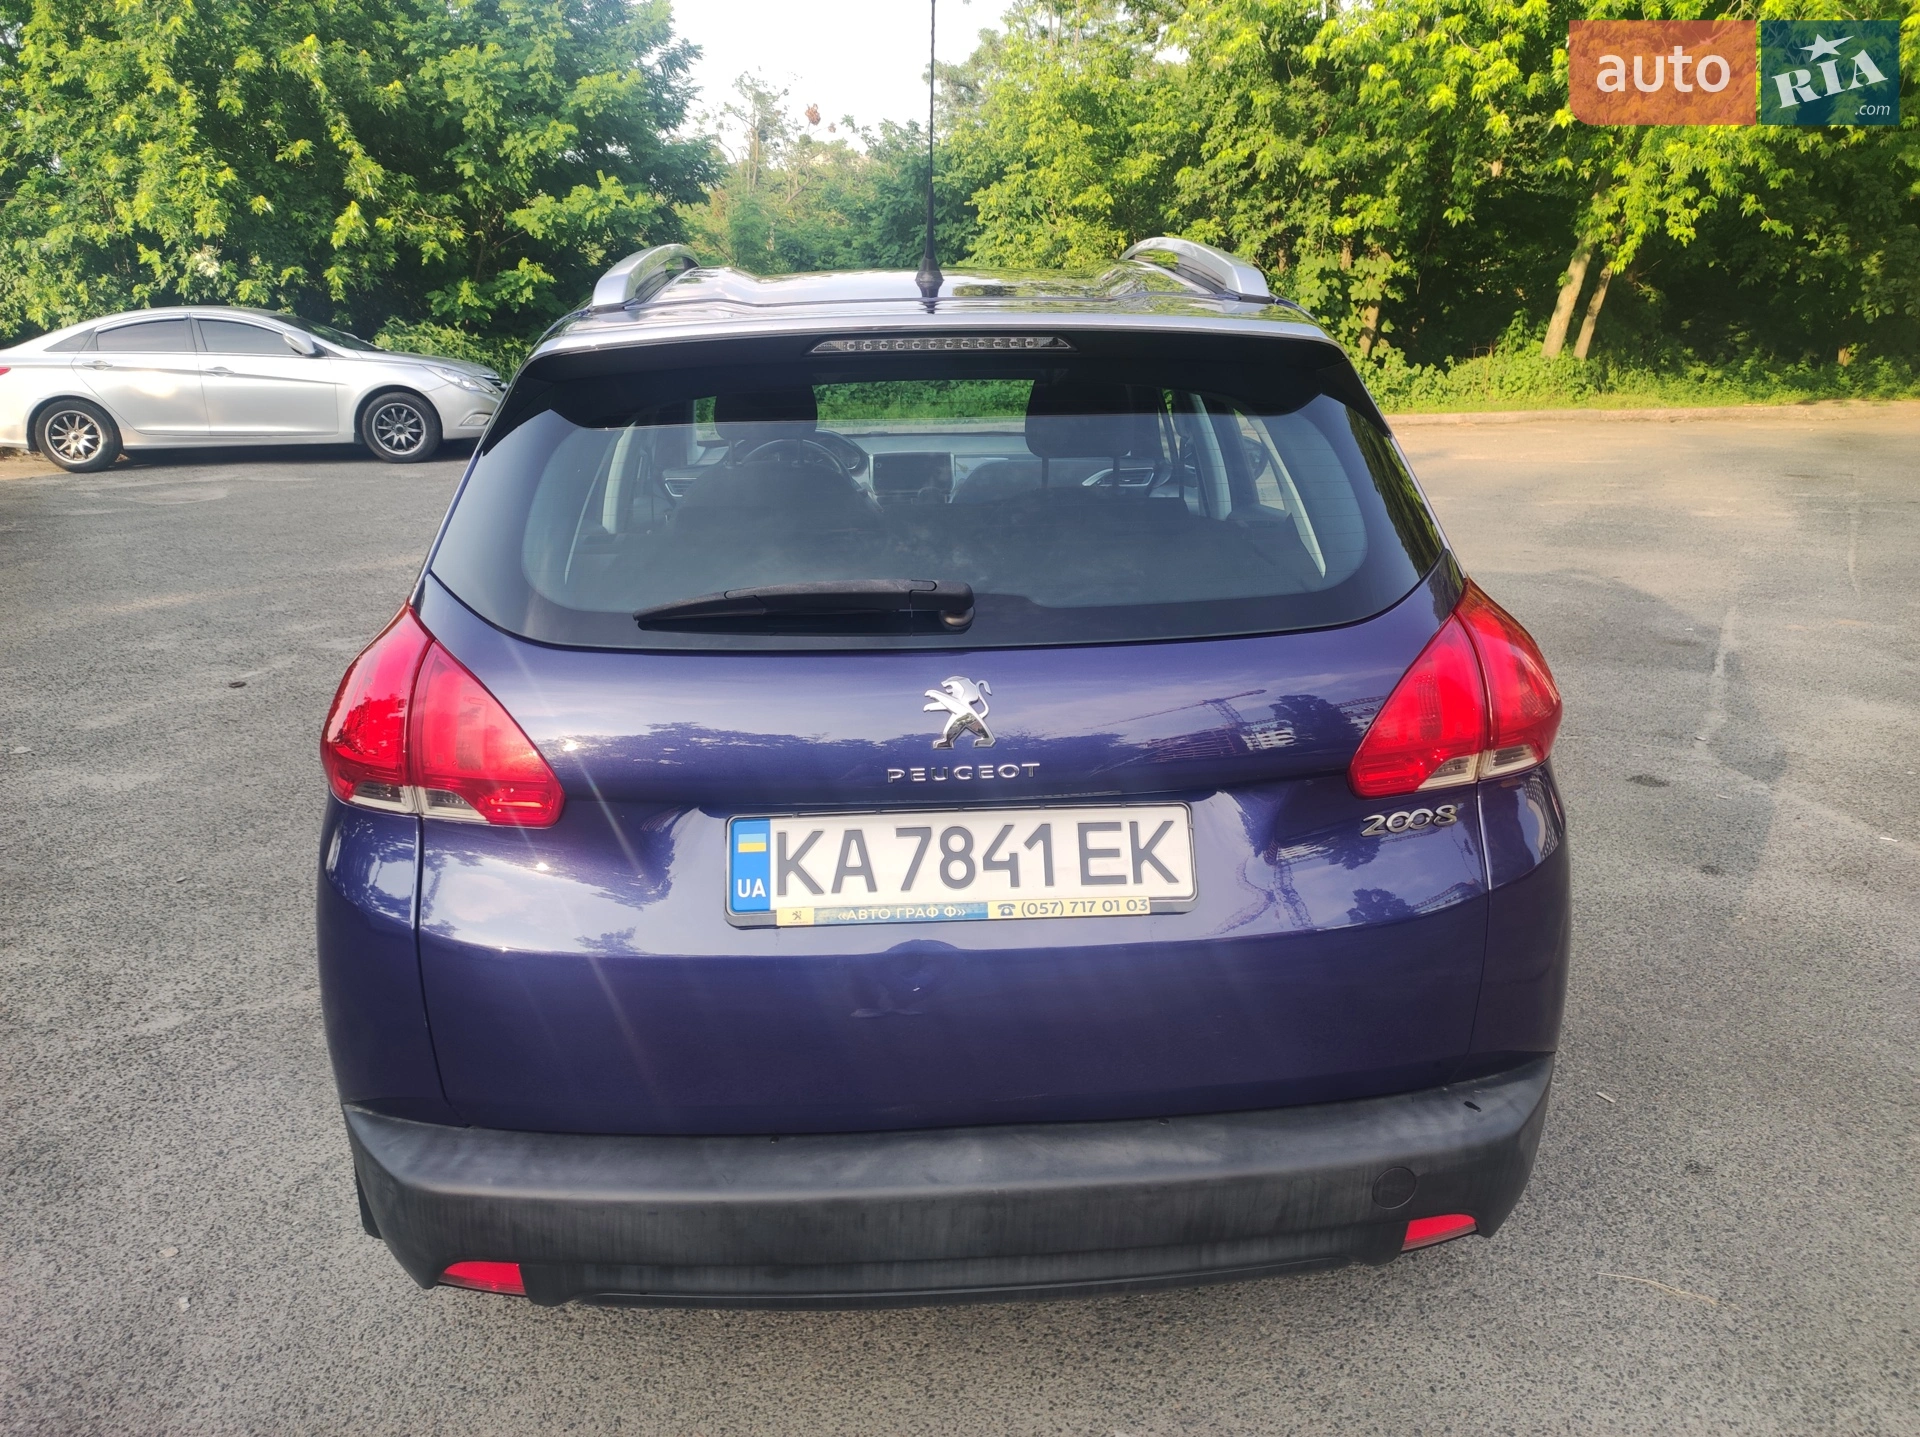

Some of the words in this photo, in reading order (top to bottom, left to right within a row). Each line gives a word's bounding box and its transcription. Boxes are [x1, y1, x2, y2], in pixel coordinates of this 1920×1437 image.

[887, 762, 1041, 784] PEUGEOT
[1361, 804, 1458, 837] 2008
[776, 828, 878, 896] KA
[895, 822, 1056, 892] 7841
[1077, 820, 1180, 886] EK
[737, 878, 767, 898] UA
[1021, 900, 1064, 917] (057)
[1069, 900, 1097, 914] 717
[1102, 899, 1121, 913] 01
[1126, 898, 1149, 912] 03
